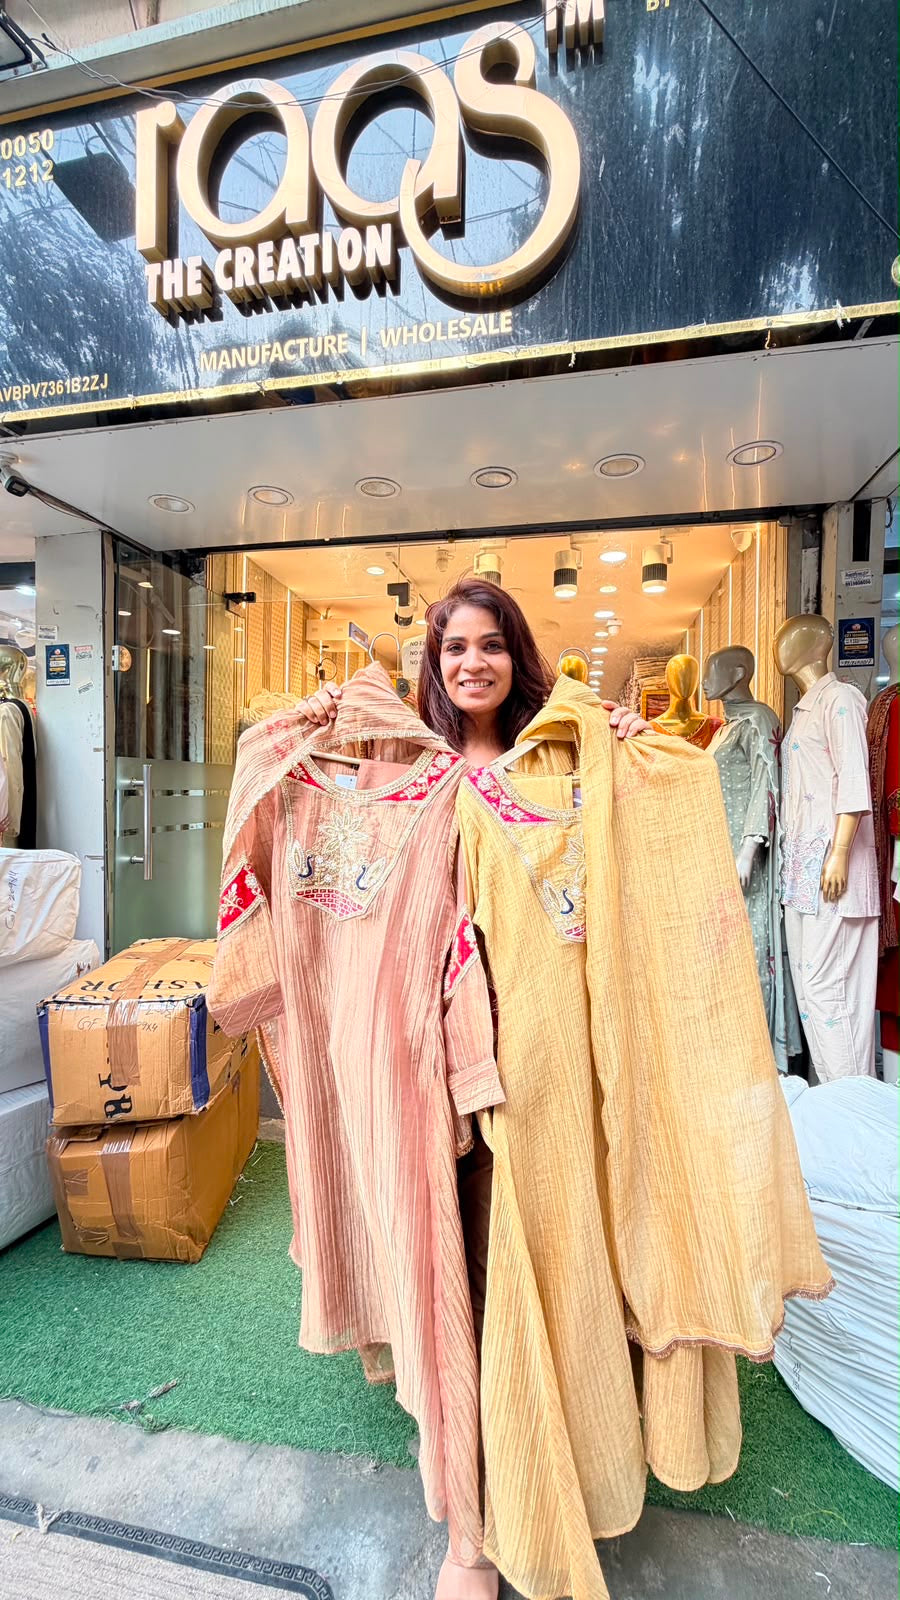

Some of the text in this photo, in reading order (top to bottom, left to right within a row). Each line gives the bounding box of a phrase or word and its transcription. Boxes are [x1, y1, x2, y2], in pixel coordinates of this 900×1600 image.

[2, 159, 54, 190] 1212
[145, 223, 392, 303] THE CREATION
[200, 310, 513, 372] MANUFACTURE WHOLESALE
